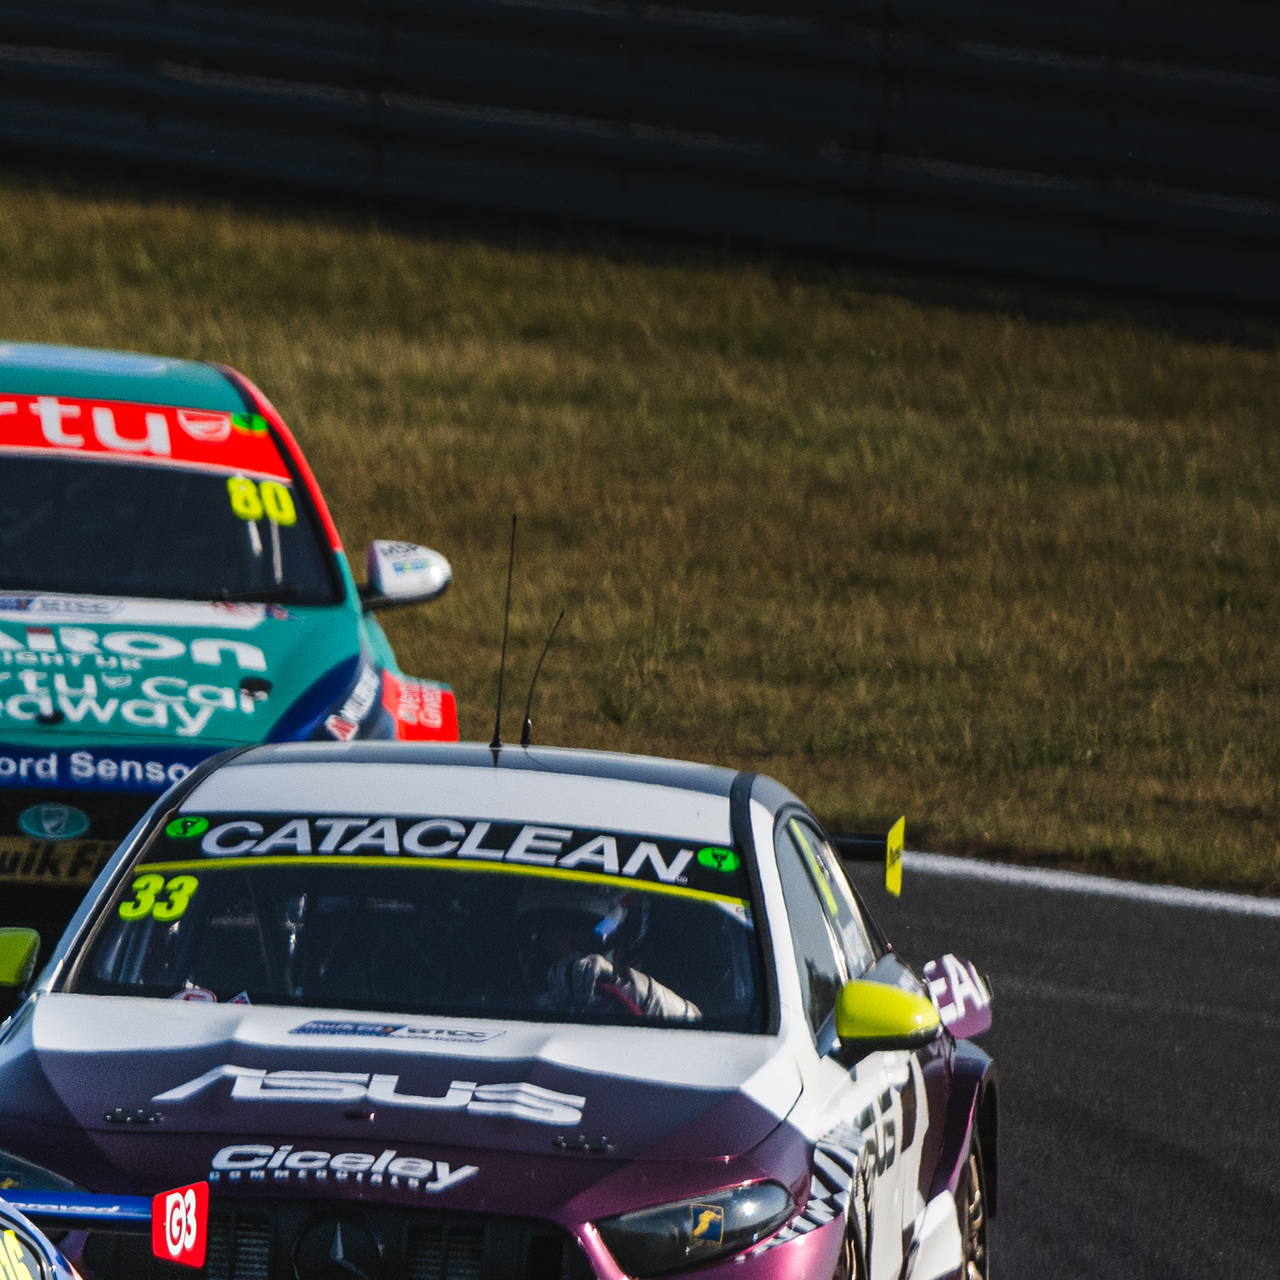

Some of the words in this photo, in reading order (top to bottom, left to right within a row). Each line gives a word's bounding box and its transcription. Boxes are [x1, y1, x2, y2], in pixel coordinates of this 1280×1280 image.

[227, 475, 295, 526] 80
[69, 751, 192, 783] Senso
[201, 817, 695, 884] CATACLEAN
[118, 874, 199, 922] 33
[923, 953, 992, 1025] EA
[152, 1065, 586, 1125] ASUS
[211, 1144, 480, 1193] Ciceley
